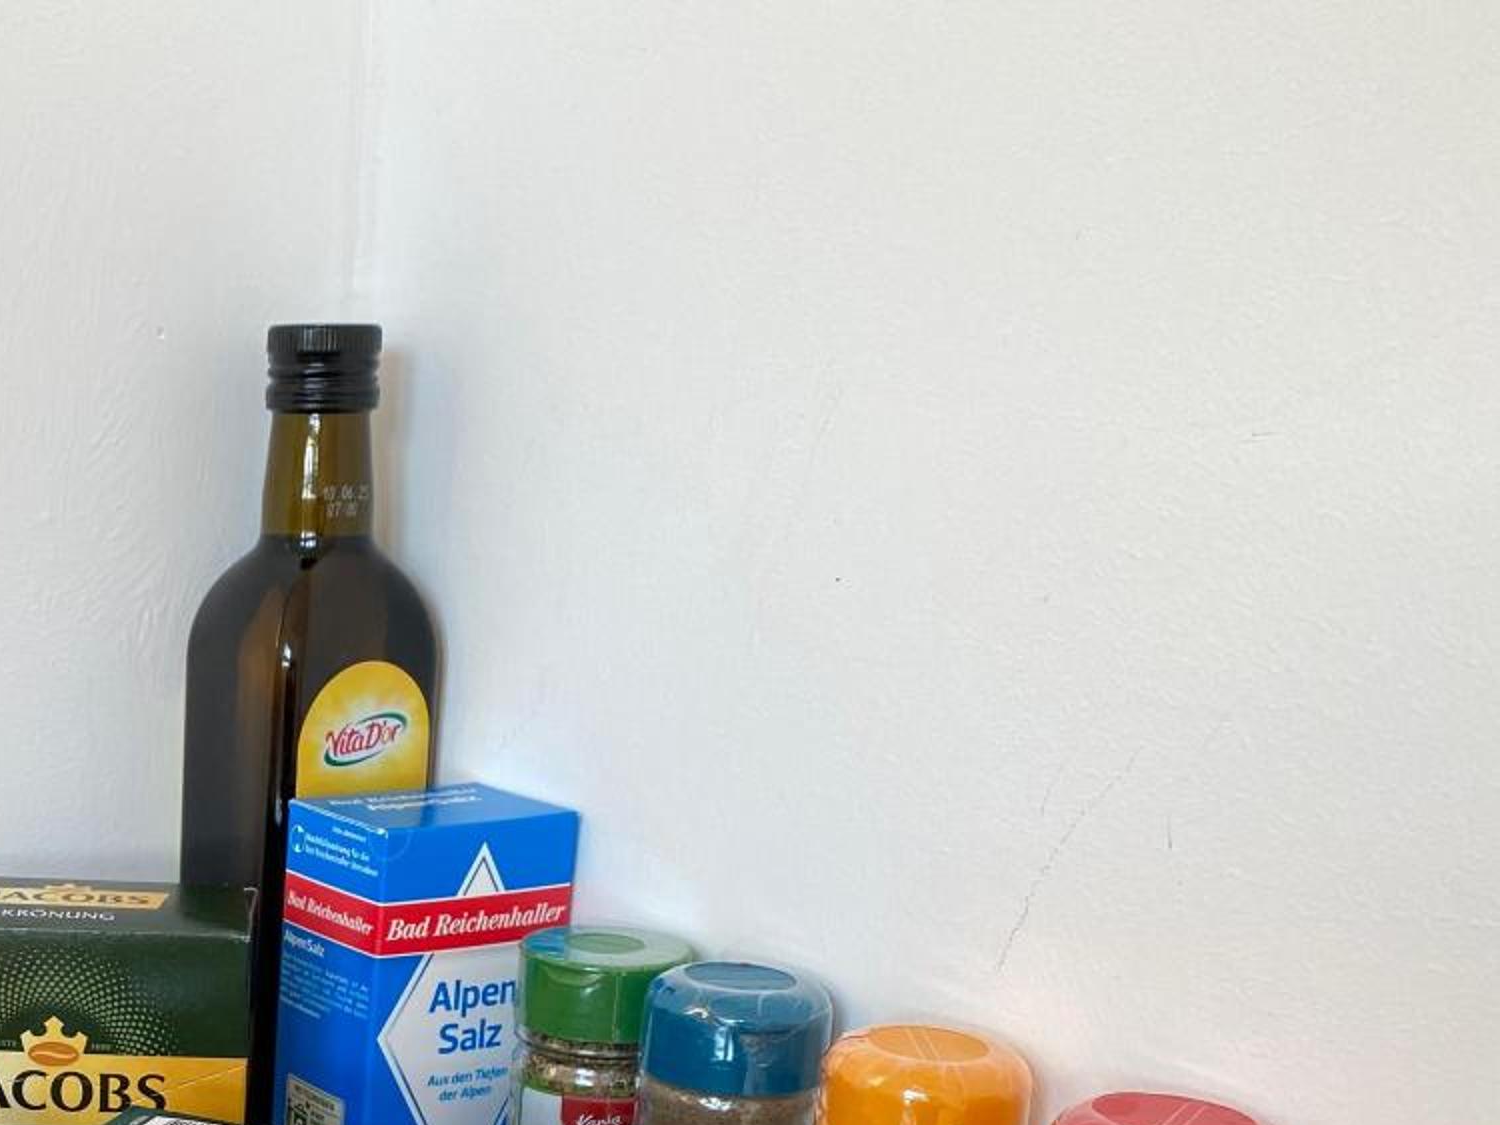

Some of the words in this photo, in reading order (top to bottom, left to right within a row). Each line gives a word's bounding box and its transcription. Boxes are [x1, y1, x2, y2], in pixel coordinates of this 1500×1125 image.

[386, 912, 429, 942] Bad
[434, 901, 568, 937] Reichenhaller
[428, 978, 517, 1019] Alpen
[437, 1019, 502, 1055] Salz
[427, 1074, 450, 1088] Aus
[451, 1071, 473, 1084] den
[439, 1089, 458, 1102] der
[460, 1084, 492, 1100] Alpen
